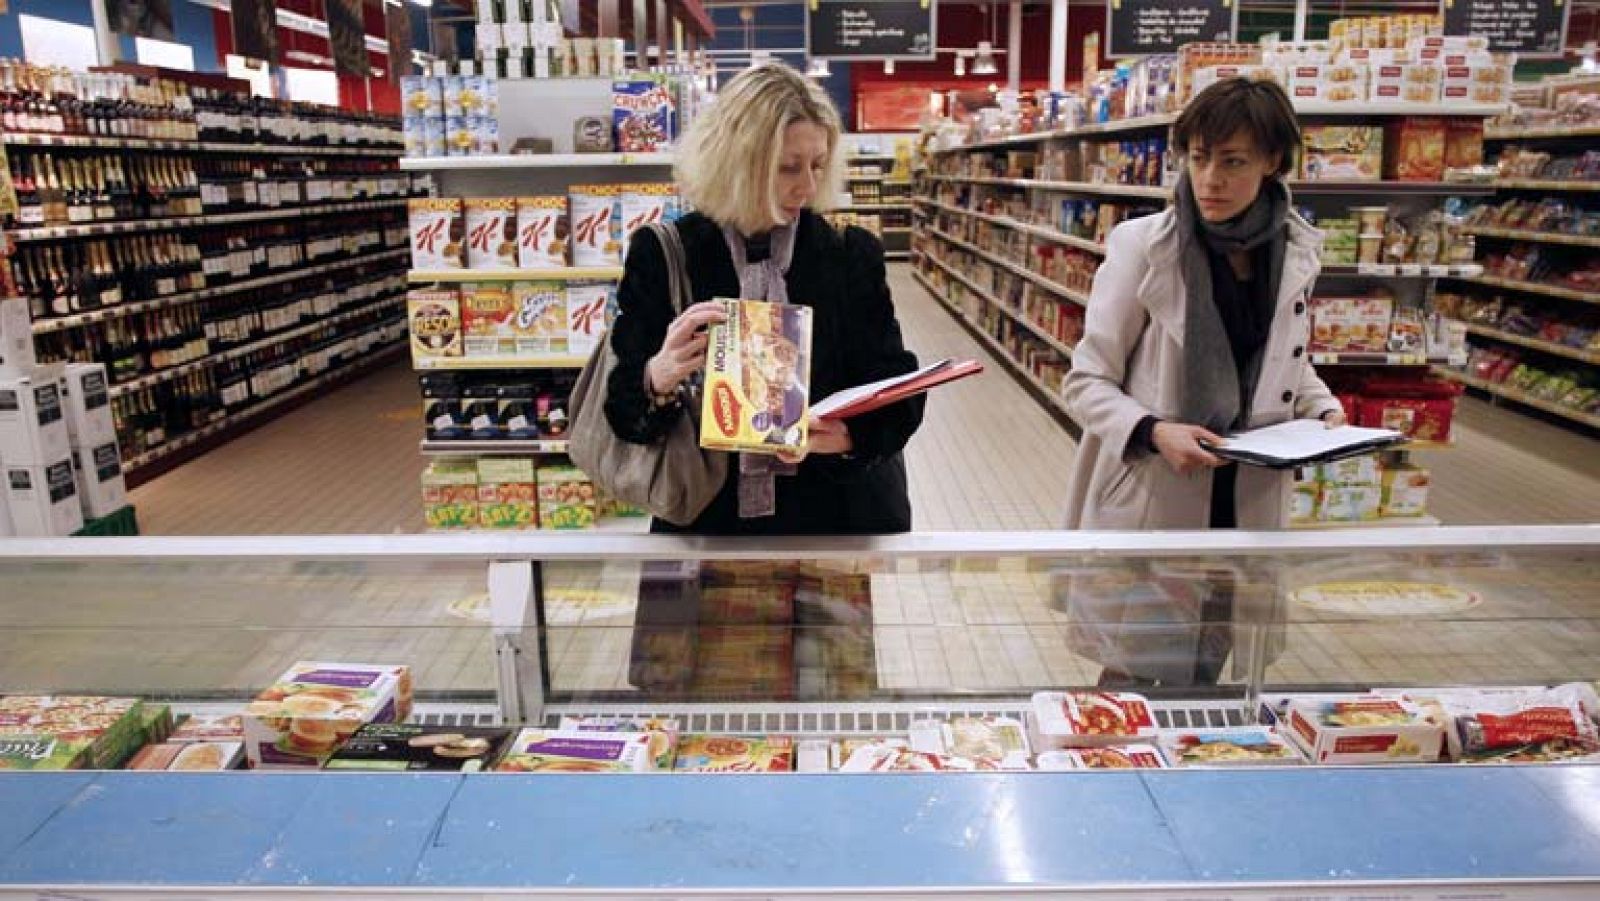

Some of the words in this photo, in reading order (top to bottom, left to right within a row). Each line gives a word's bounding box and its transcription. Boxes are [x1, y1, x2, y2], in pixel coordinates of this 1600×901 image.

[416, 217, 448, 255] K
[470, 216, 501, 253] K
[522, 215, 551, 251] K
[577, 206, 610, 247] K
[572, 296, 605, 334] K
